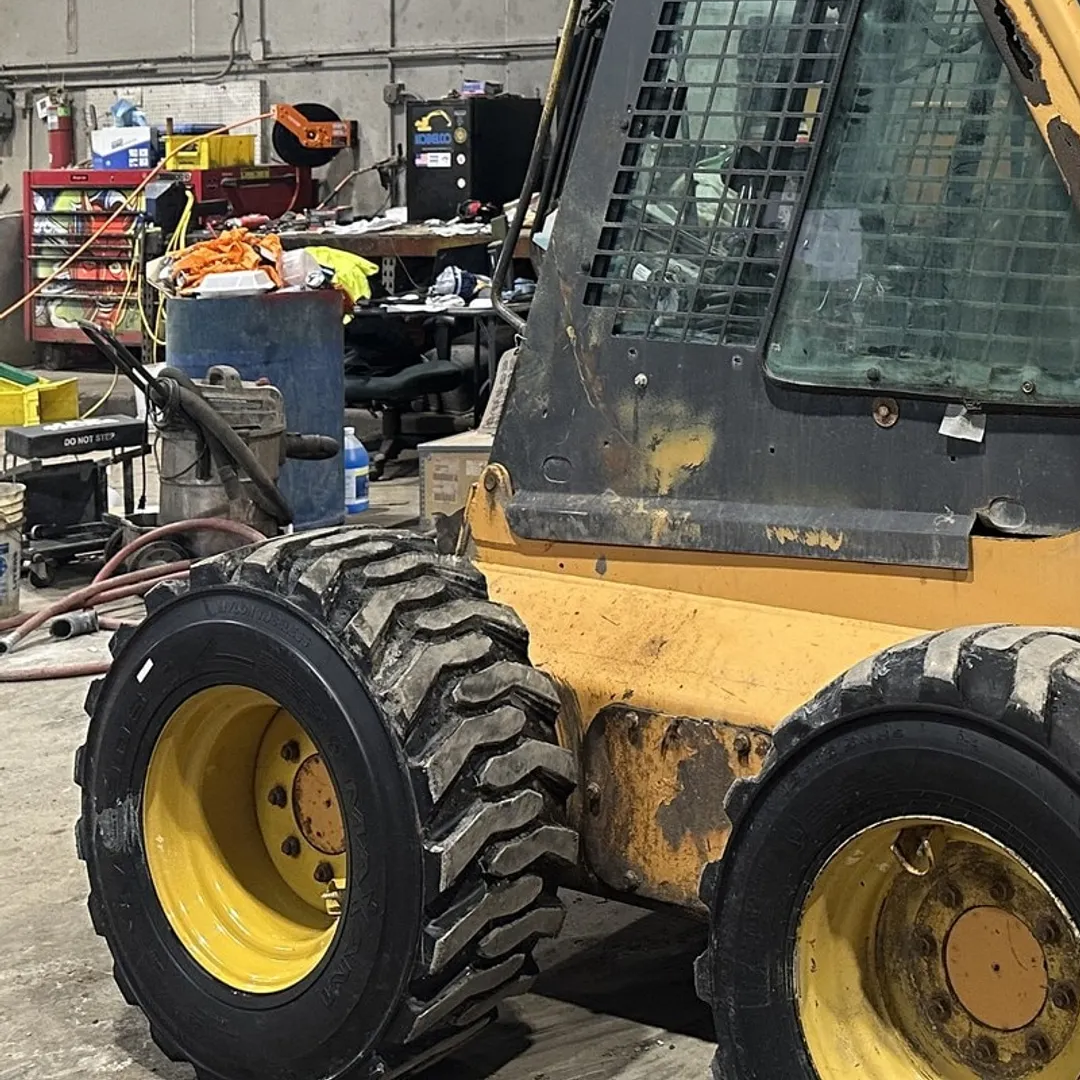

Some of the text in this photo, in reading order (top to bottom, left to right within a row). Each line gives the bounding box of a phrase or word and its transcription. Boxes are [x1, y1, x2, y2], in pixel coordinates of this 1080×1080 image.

[64, 432, 115, 447] DO NOT STEP
